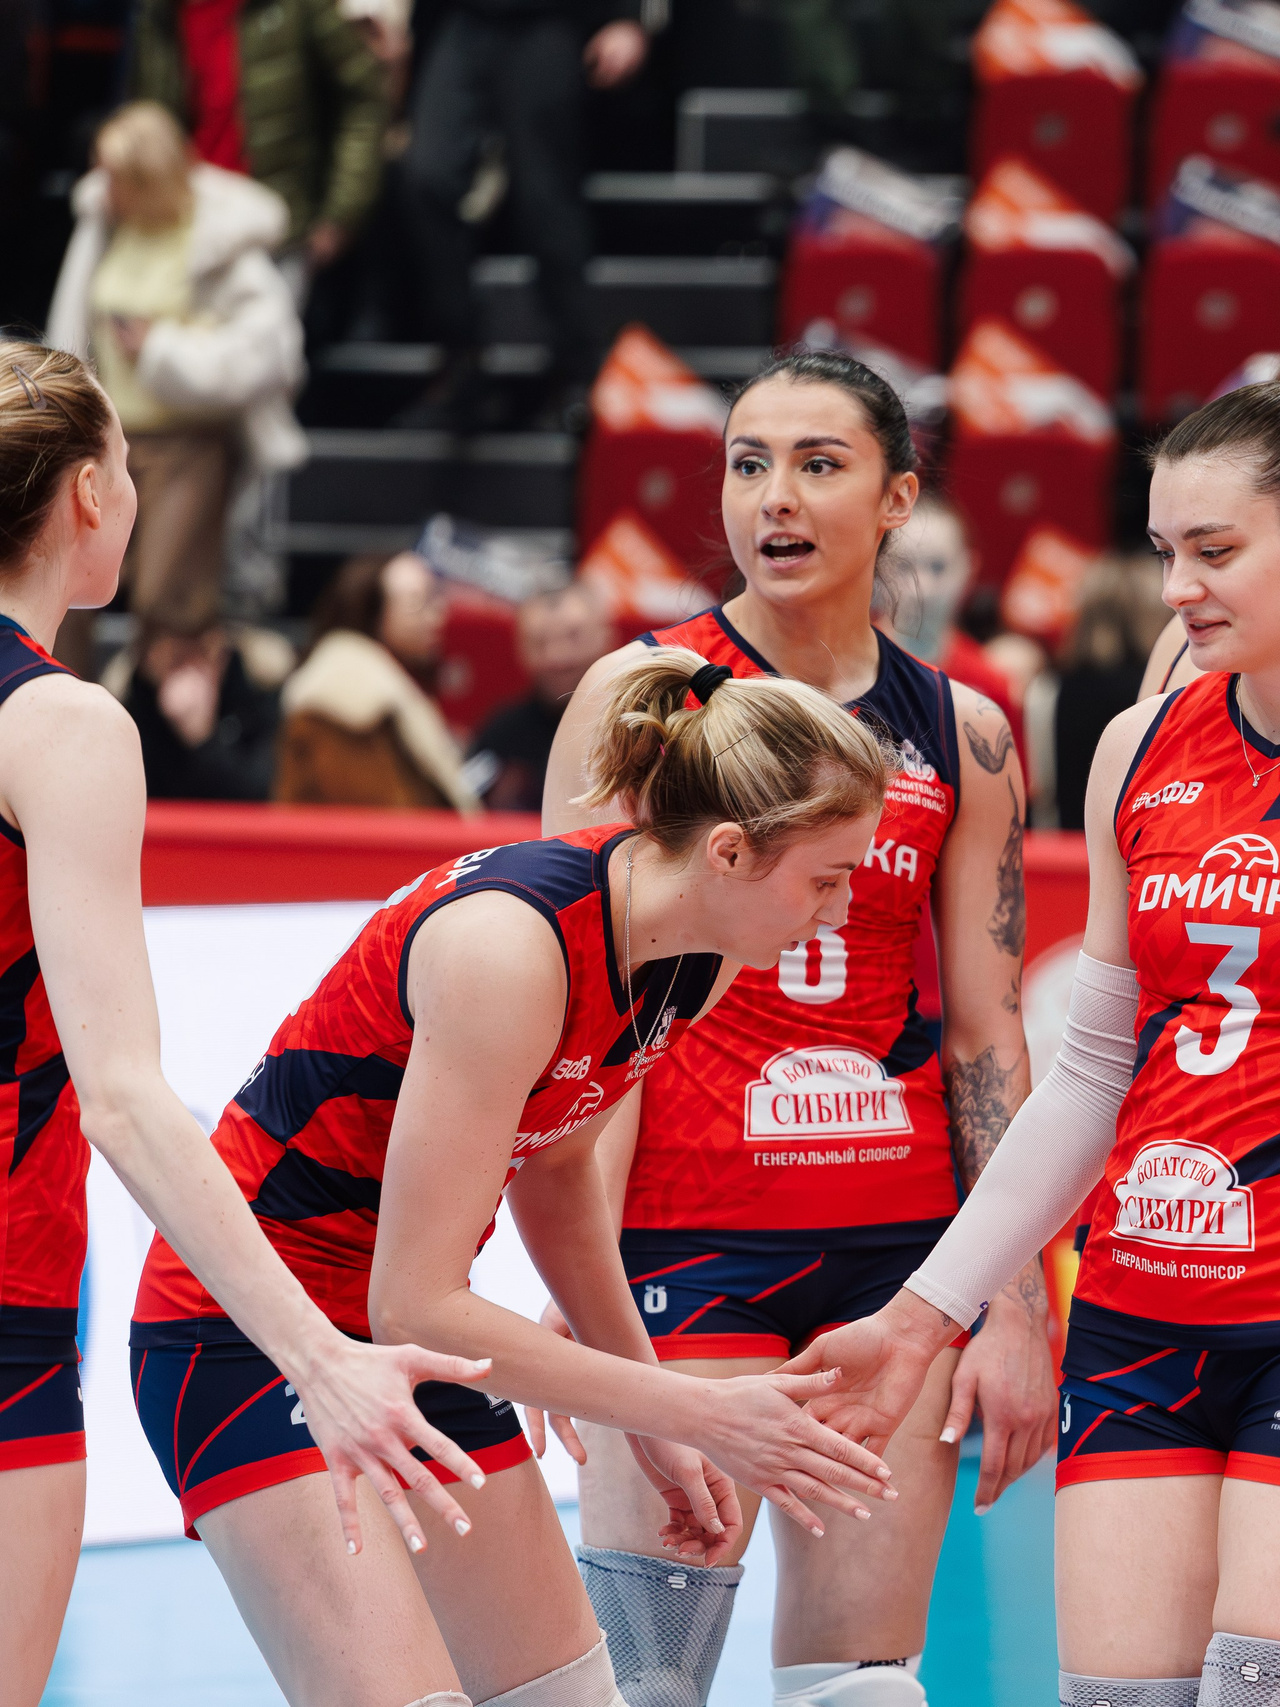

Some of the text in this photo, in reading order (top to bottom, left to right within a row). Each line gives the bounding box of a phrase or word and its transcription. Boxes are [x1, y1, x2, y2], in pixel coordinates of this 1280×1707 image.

[1174, 921, 1261, 1076] 3
[783, 1058, 871, 1084] БОГАТСТВО
[771, 1089, 889, 1126] СИБИРИ
[753, 1145, 912, 1167] ГЕНЕРАЛЬНЫЙ СПОНСОР
[1137, 1156, 1217, 1188] БОГАТСТВО
[1123, 1196, 1227, 1236] СИБИРИ
[1111, 1248, 1247, 1280] ГЕНЕРАЛЬНЫЙ СПОНСОР
